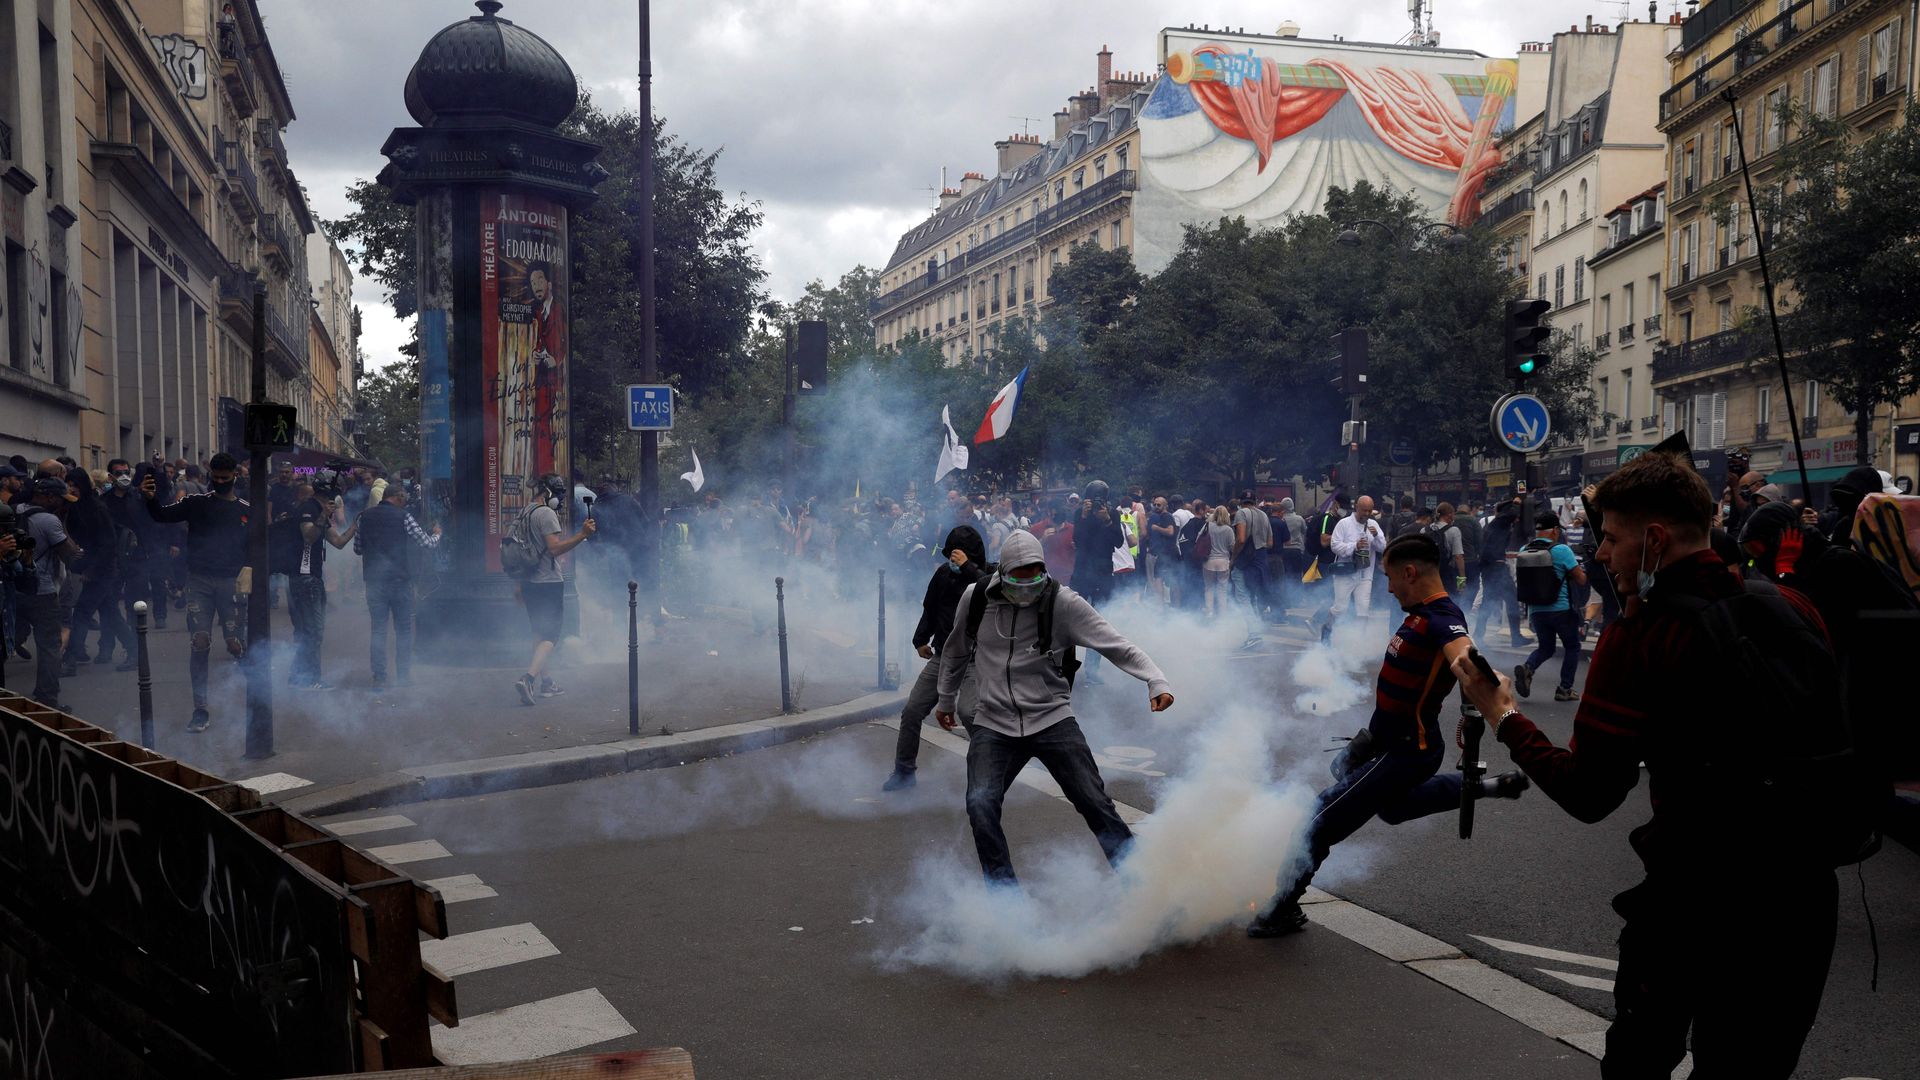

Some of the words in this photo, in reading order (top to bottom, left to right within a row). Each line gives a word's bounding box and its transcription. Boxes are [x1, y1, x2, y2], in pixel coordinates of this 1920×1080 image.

[497, 208, 557, 228] ANTOINE
[483, 222, 495, 281] THÉÂTRE
[506, 238, 552, 263] EDOUARD
[502, 303, 533, 314] CHRISTOPHE
[502, 312, 524, 321] MEYNET
[632, 401, 670, 414] TAXIS
[1787, 448, 1822, 462] ALENTS
[488, 446, 497, 535] WWW.THEATRE-ANTOINE.COM
